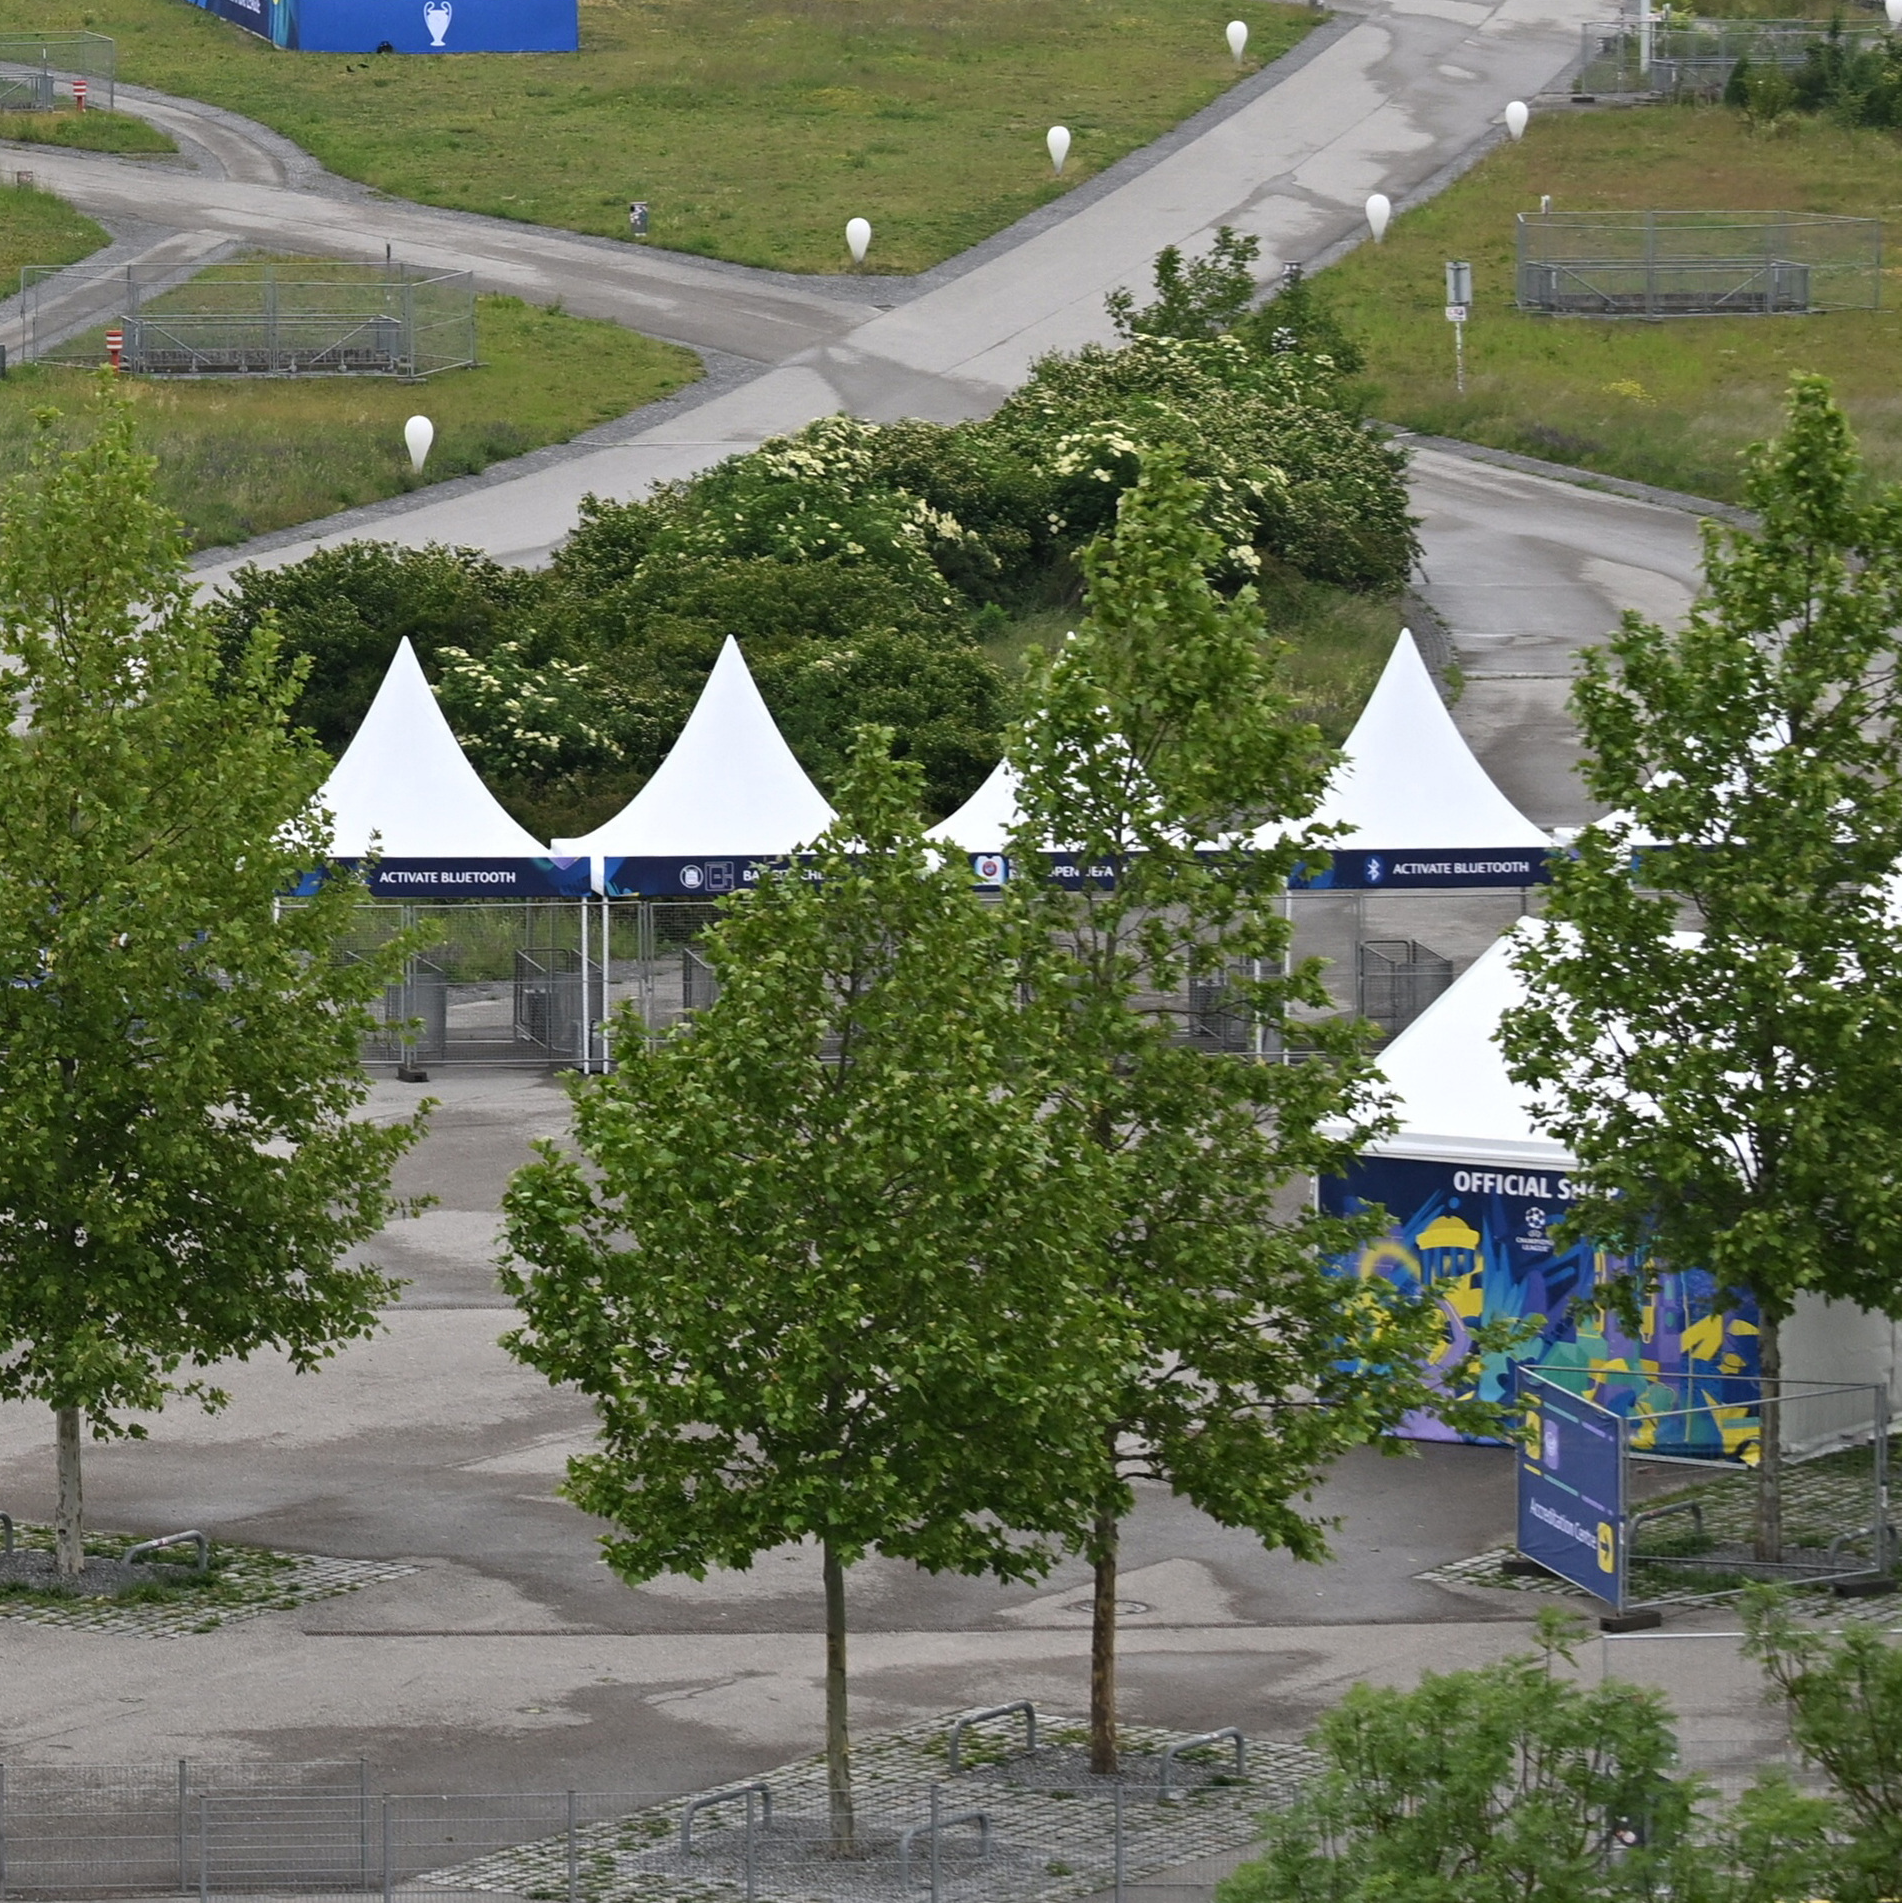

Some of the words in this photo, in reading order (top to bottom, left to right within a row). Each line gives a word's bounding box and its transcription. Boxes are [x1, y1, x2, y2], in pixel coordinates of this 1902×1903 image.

[379, 871, 438, 884] ACTIVATE
[440, 871, 516, 884] BLUETOOTH
[1392, 861, 1452, 875] ACTIVATE
[1453, 861, 1530, 874] BLUETOOTH
[1453, 1170, 1552, 1198] OFFICIAL
[1529, 1497, 1574, 1537] Accreditation
